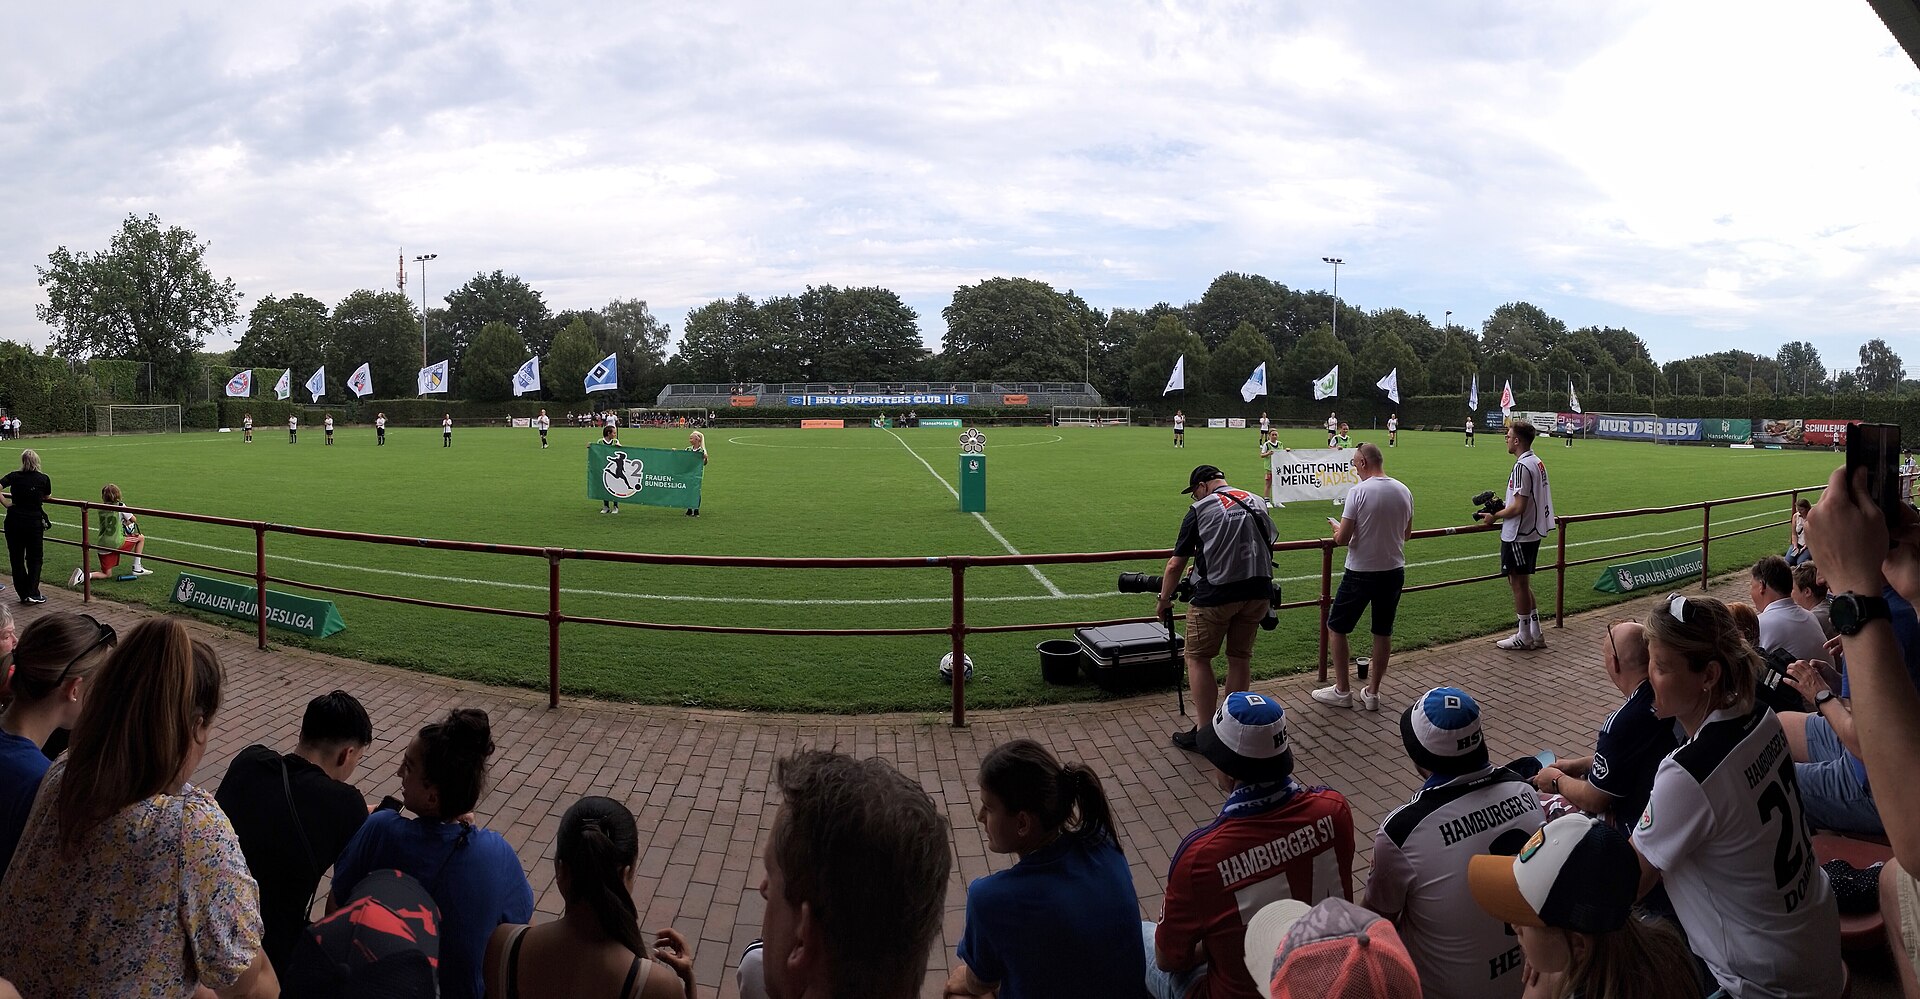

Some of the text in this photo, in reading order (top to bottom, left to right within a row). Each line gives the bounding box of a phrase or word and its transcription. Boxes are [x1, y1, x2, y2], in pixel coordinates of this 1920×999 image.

[815, 396, 838, 404] HSV
[839, 396, 911, 404] SUPPORTERS
[1599, 419, 1698, 436] NUR DER HSV
[1804, 424, 1847, 433] SCHULENB
[645, 481, 686, 489] BUNDESLIGA
[1281, 475, 1316, 486] MEINE
[1634, 561, 1703, 586] FRAUEN-BUNDESLIG
[1744, 734, 1783, 790] HAMBURGER
[1439, 798, 1524, 847] HAMBURGER
[1521, 791, 1538, 811] SV
[1216, 815, 1335, 887] HAMBURGER SV
